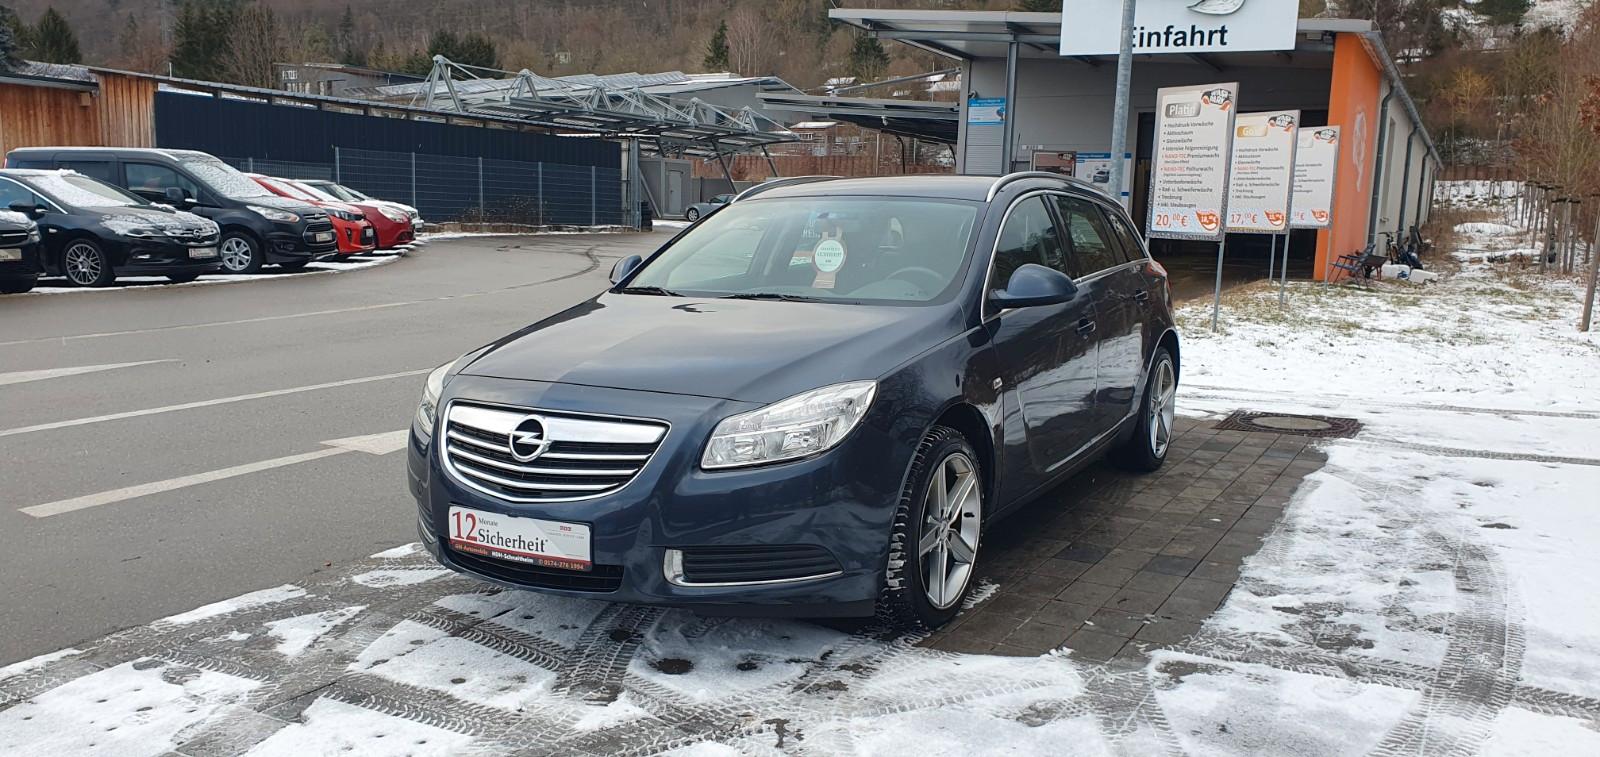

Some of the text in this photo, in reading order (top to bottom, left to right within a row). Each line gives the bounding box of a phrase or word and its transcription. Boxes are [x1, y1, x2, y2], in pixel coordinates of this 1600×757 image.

[1169, 104, 1196, 116] Platin
[452, 511, 478, 540] 12
[479, 517, 498, 527] Monate
